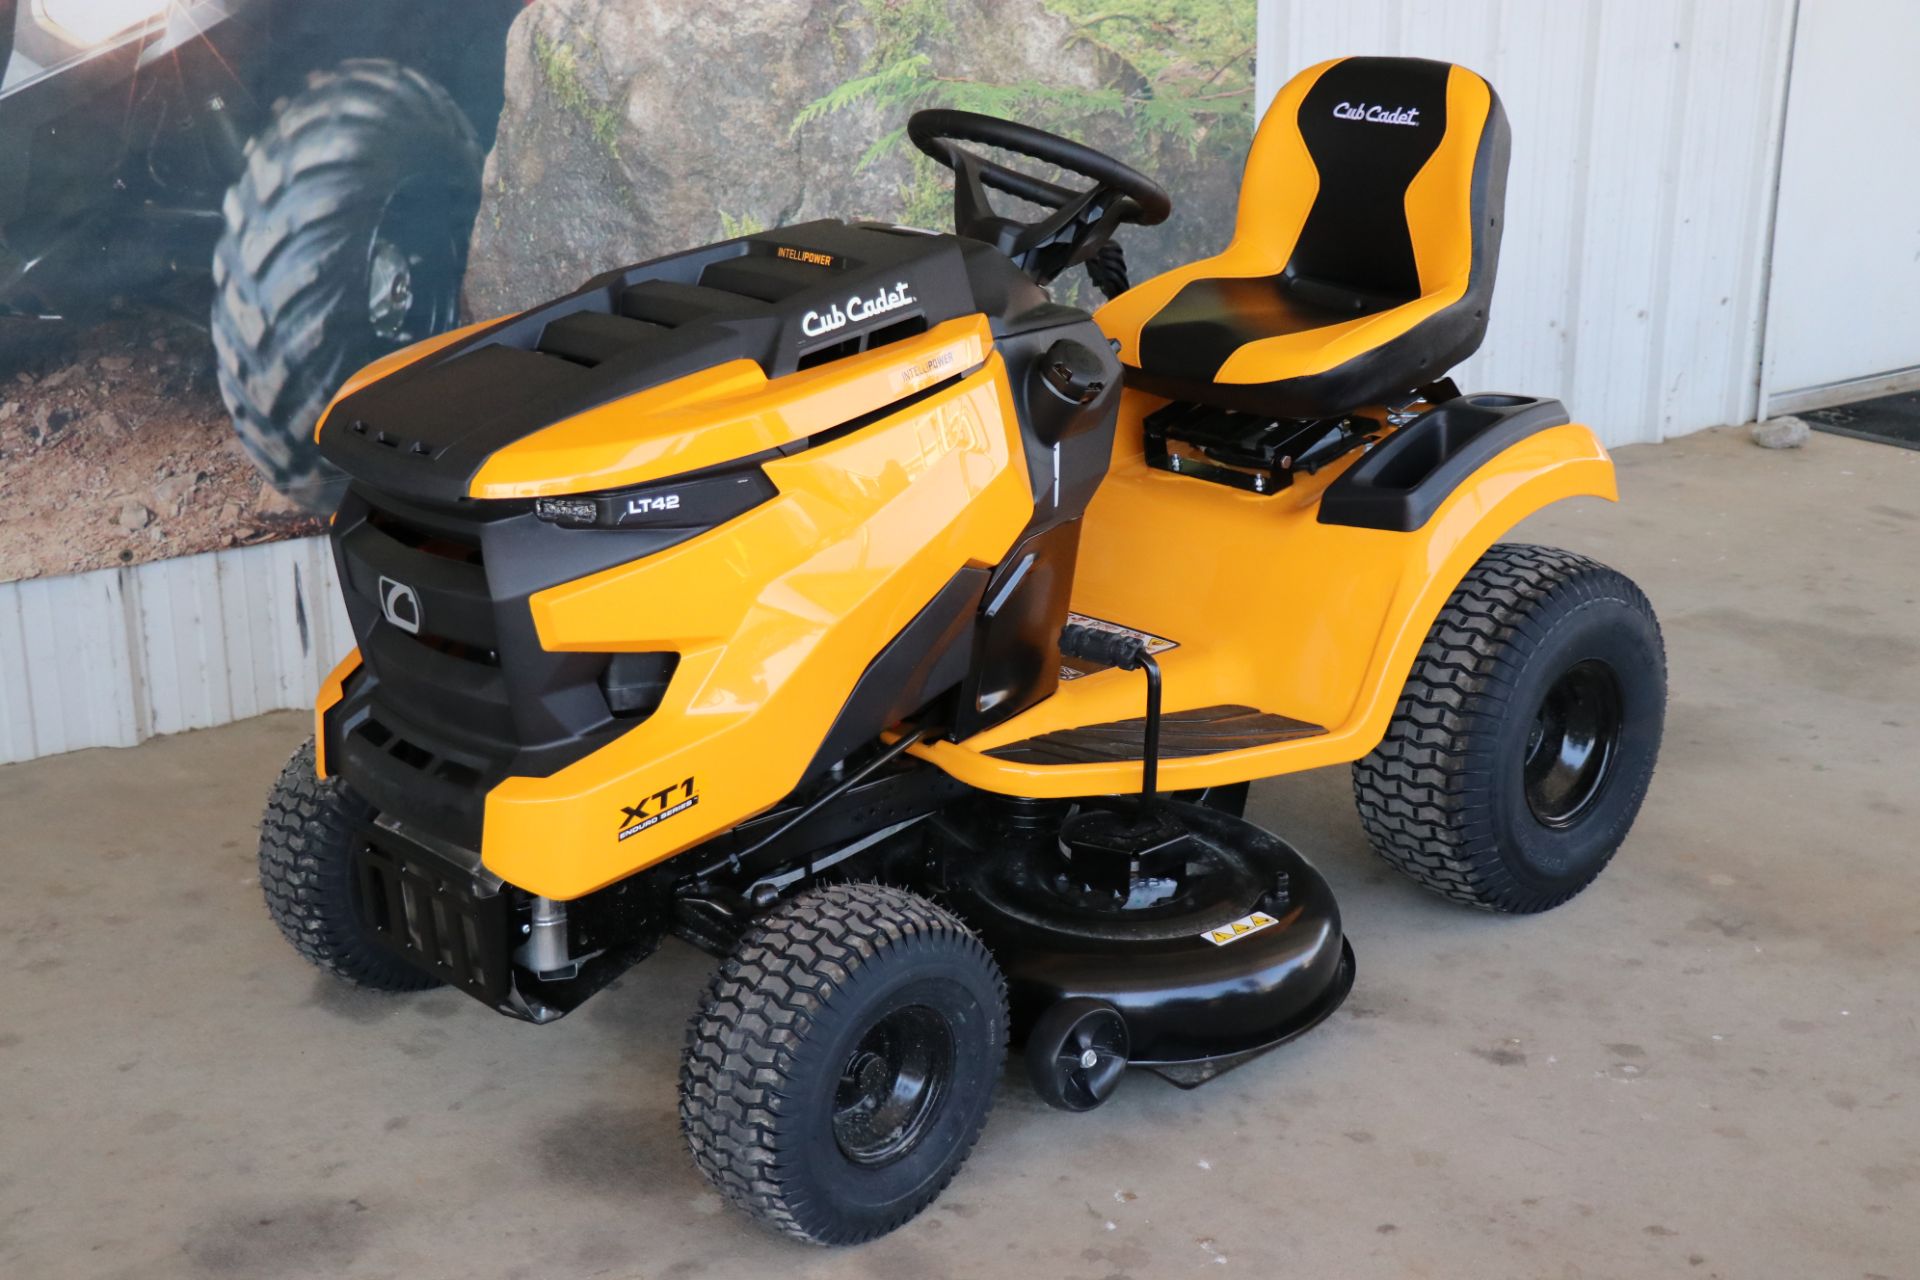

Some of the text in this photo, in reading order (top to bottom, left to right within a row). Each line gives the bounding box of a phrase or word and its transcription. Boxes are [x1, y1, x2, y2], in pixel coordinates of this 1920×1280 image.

[1333, 102, 1419, 126] Cub Cadet
[777, 247, 832, 266] INTELLIPOWER
[802, 281, 913, 337] Cub Cadet
[628, 495, 680, 514] LT42
[618, 776, 695, 829] XT1
[619, 799, 694, 840] ENDURO SERIES
